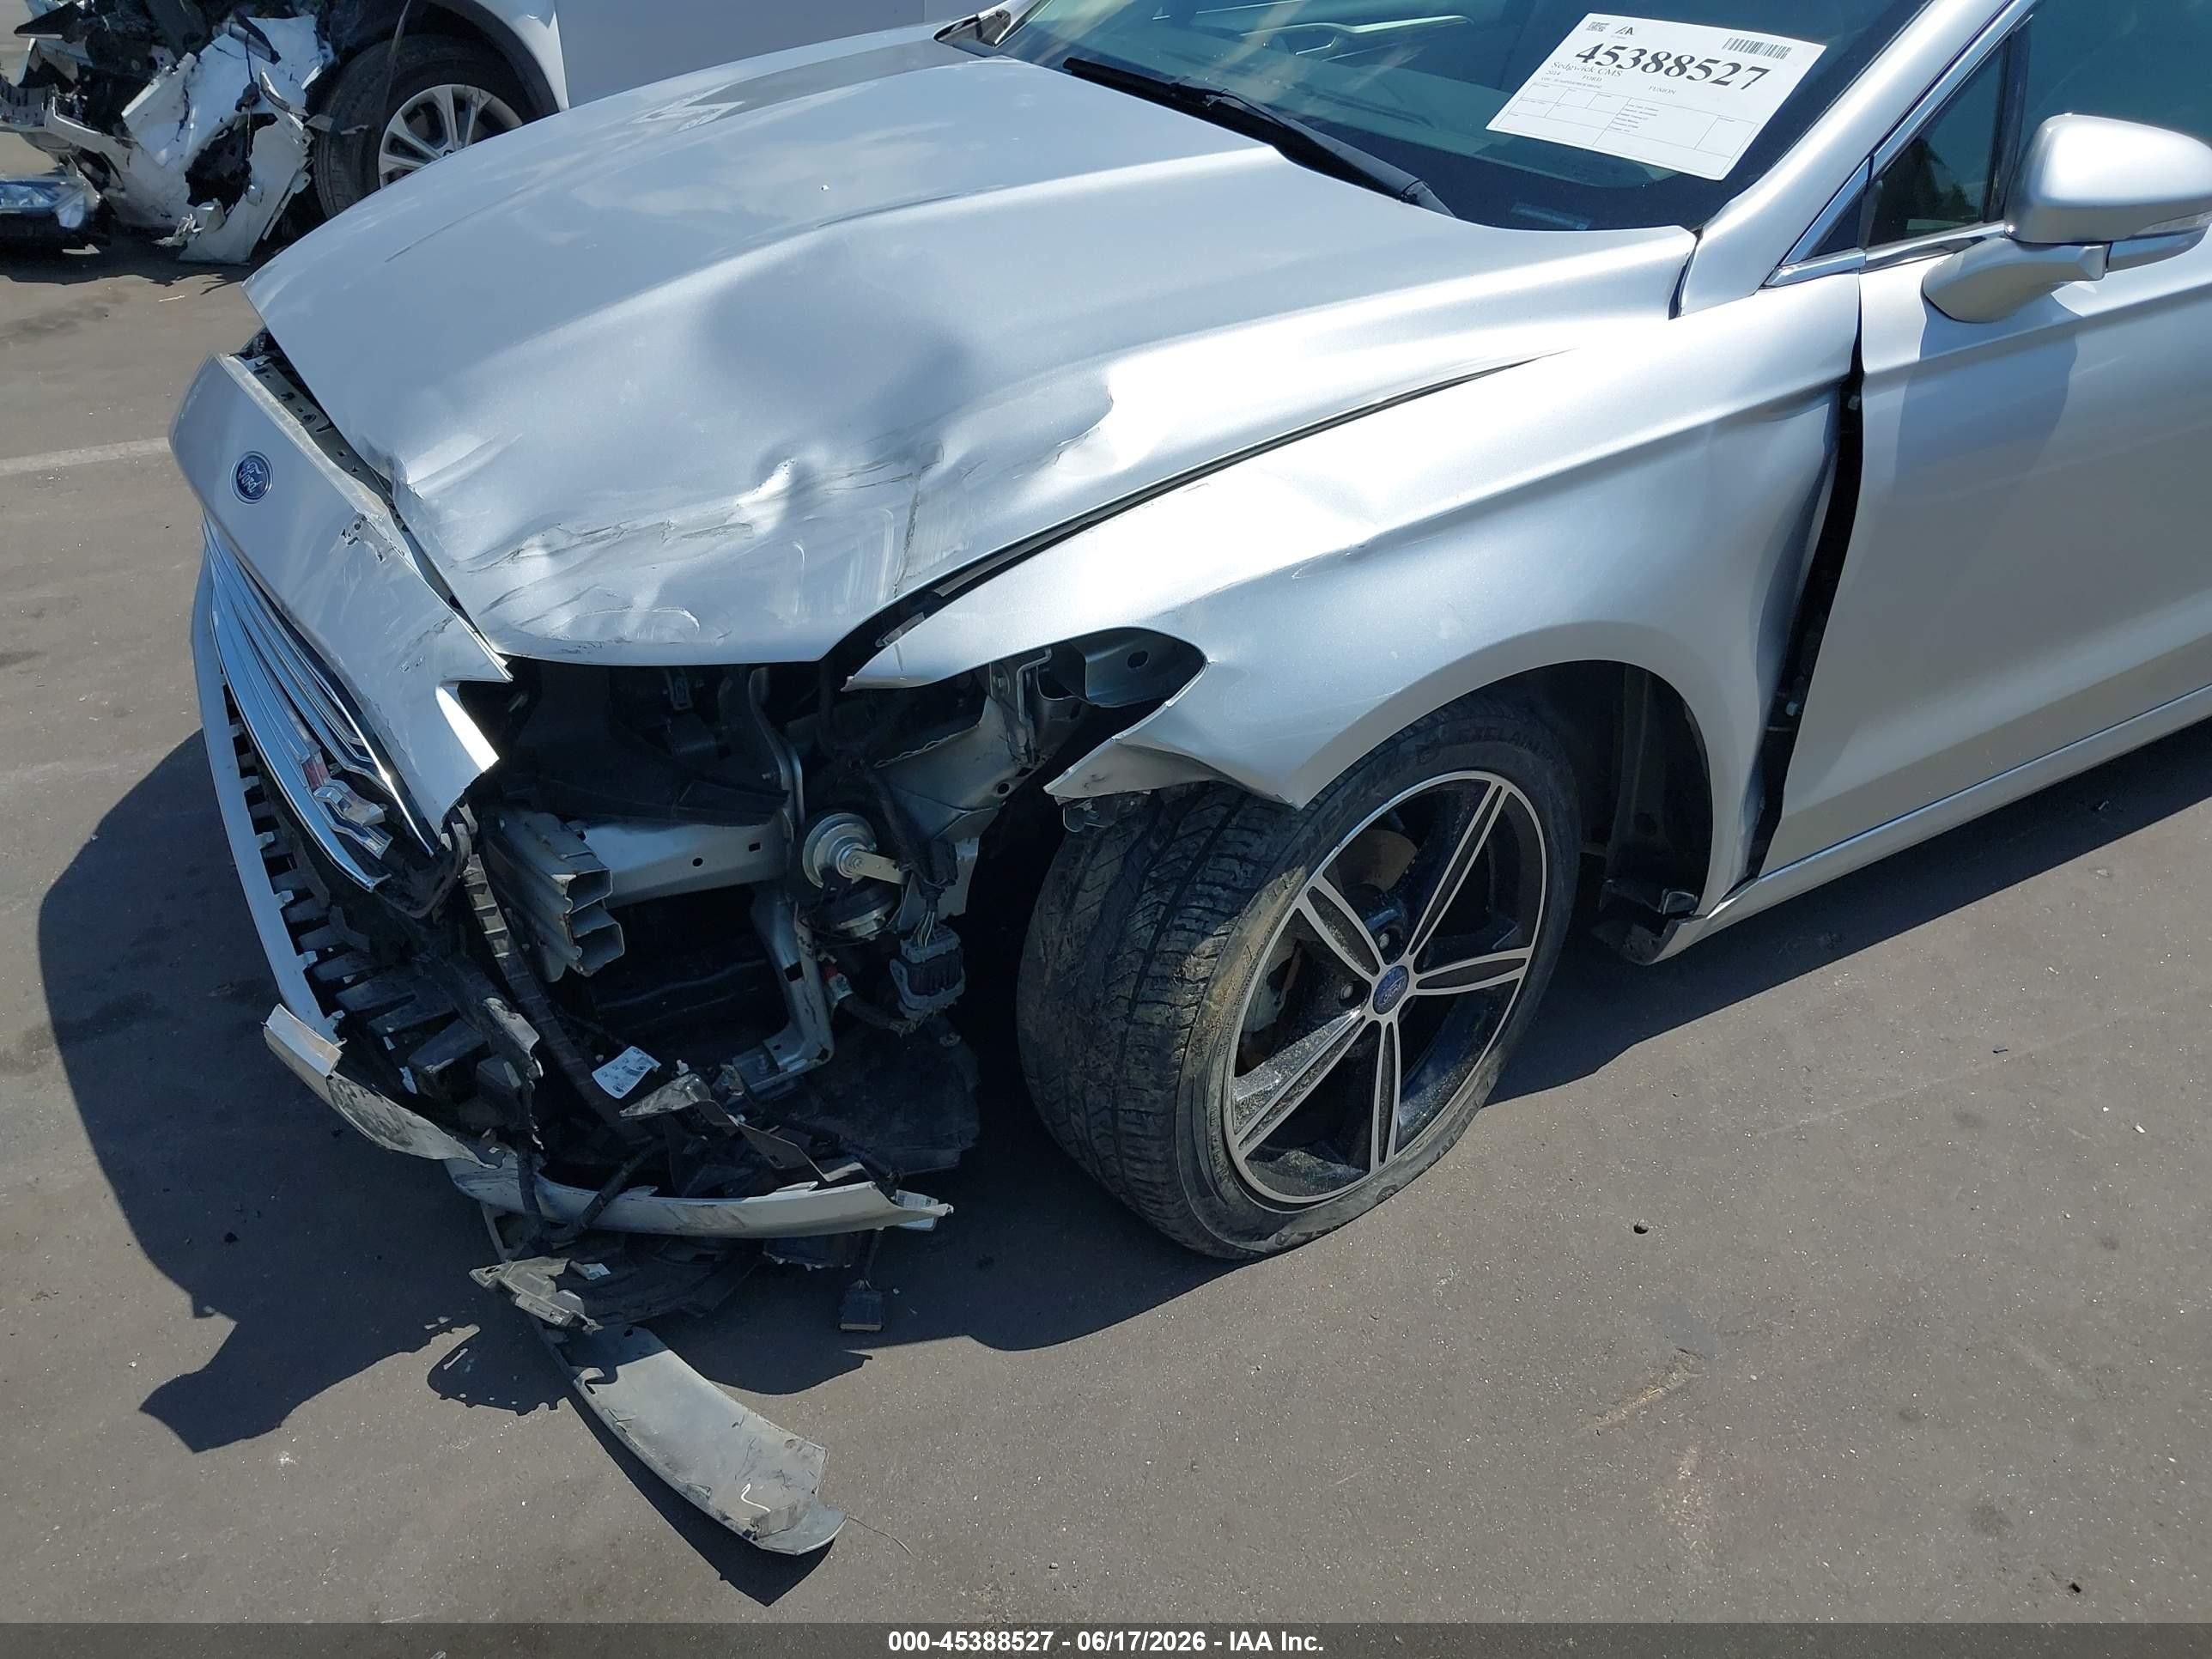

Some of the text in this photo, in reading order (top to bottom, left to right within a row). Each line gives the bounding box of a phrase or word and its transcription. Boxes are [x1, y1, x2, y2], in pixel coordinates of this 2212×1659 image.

[1551, 61, 1623, 77] Sedgwick CMS
[1574, 43, 1772, 90] 45388527
[1648, 85, 1677, 95] FUSION
